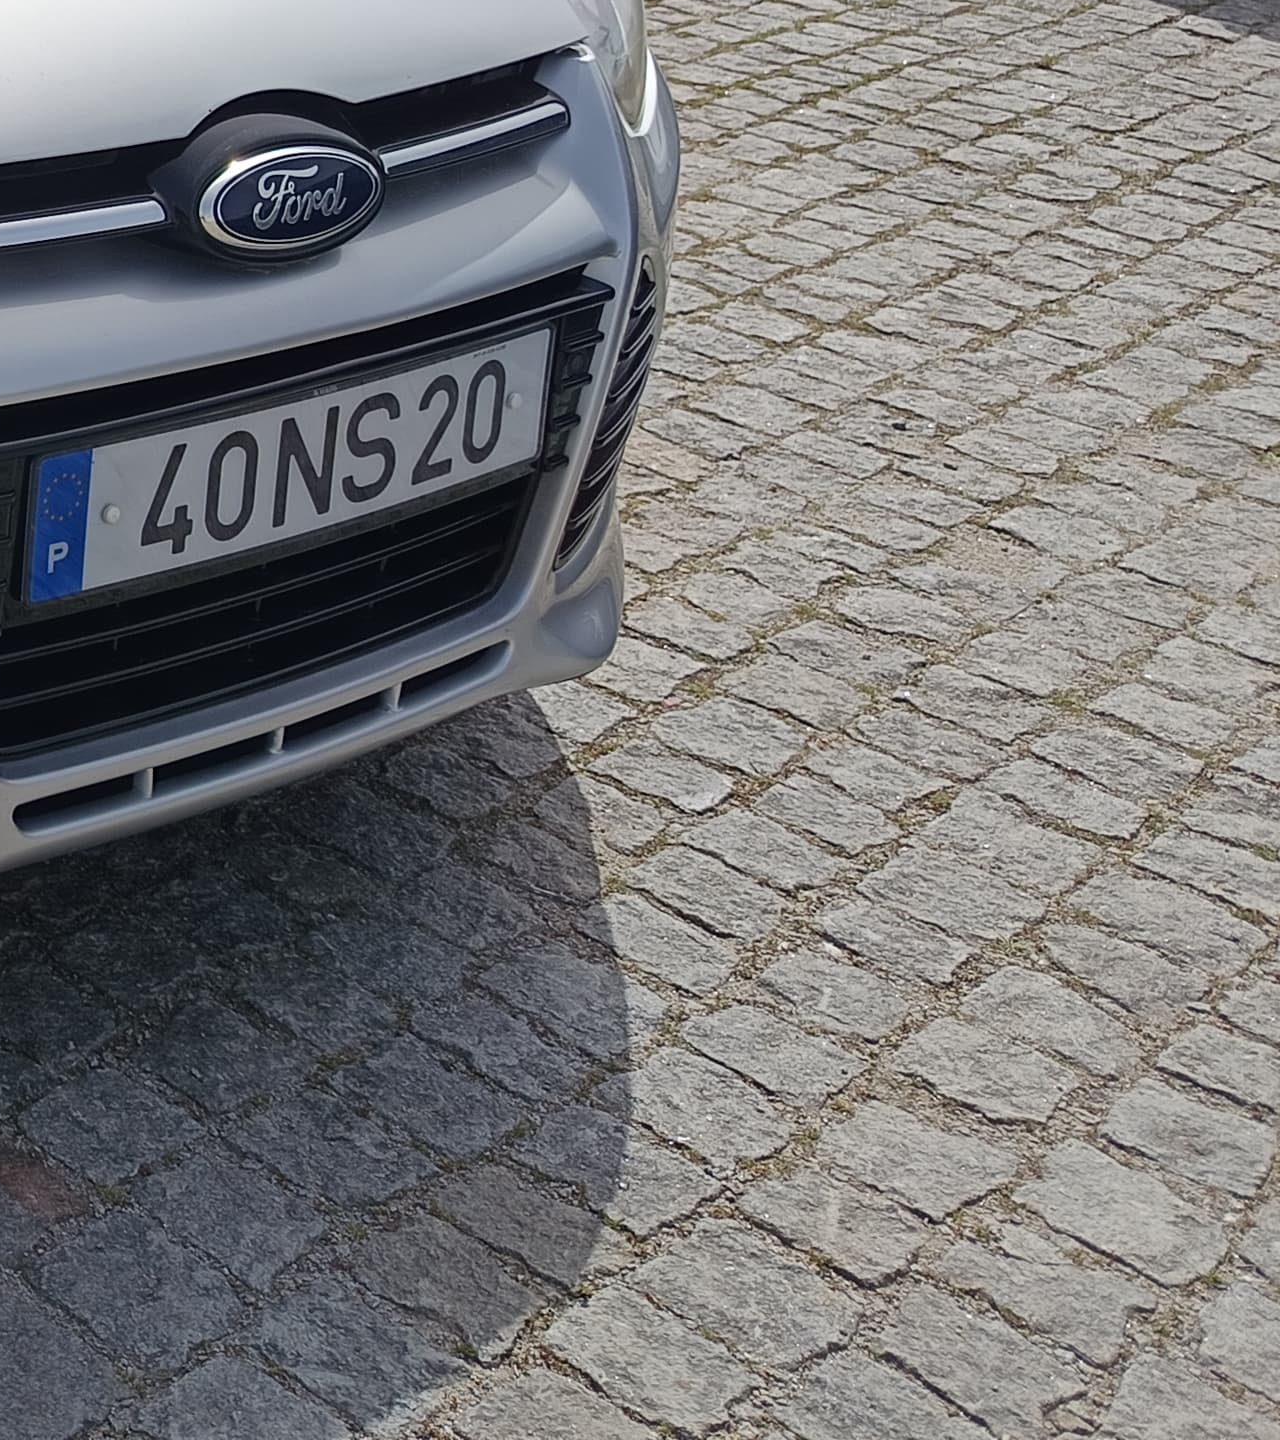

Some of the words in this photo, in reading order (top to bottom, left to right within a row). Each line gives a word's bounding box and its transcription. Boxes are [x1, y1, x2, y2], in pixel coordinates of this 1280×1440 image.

[252, 164, 347, 230] Ford
[140, 358, 507, 555] 40NS20
[47, 541, 69, 574] P
